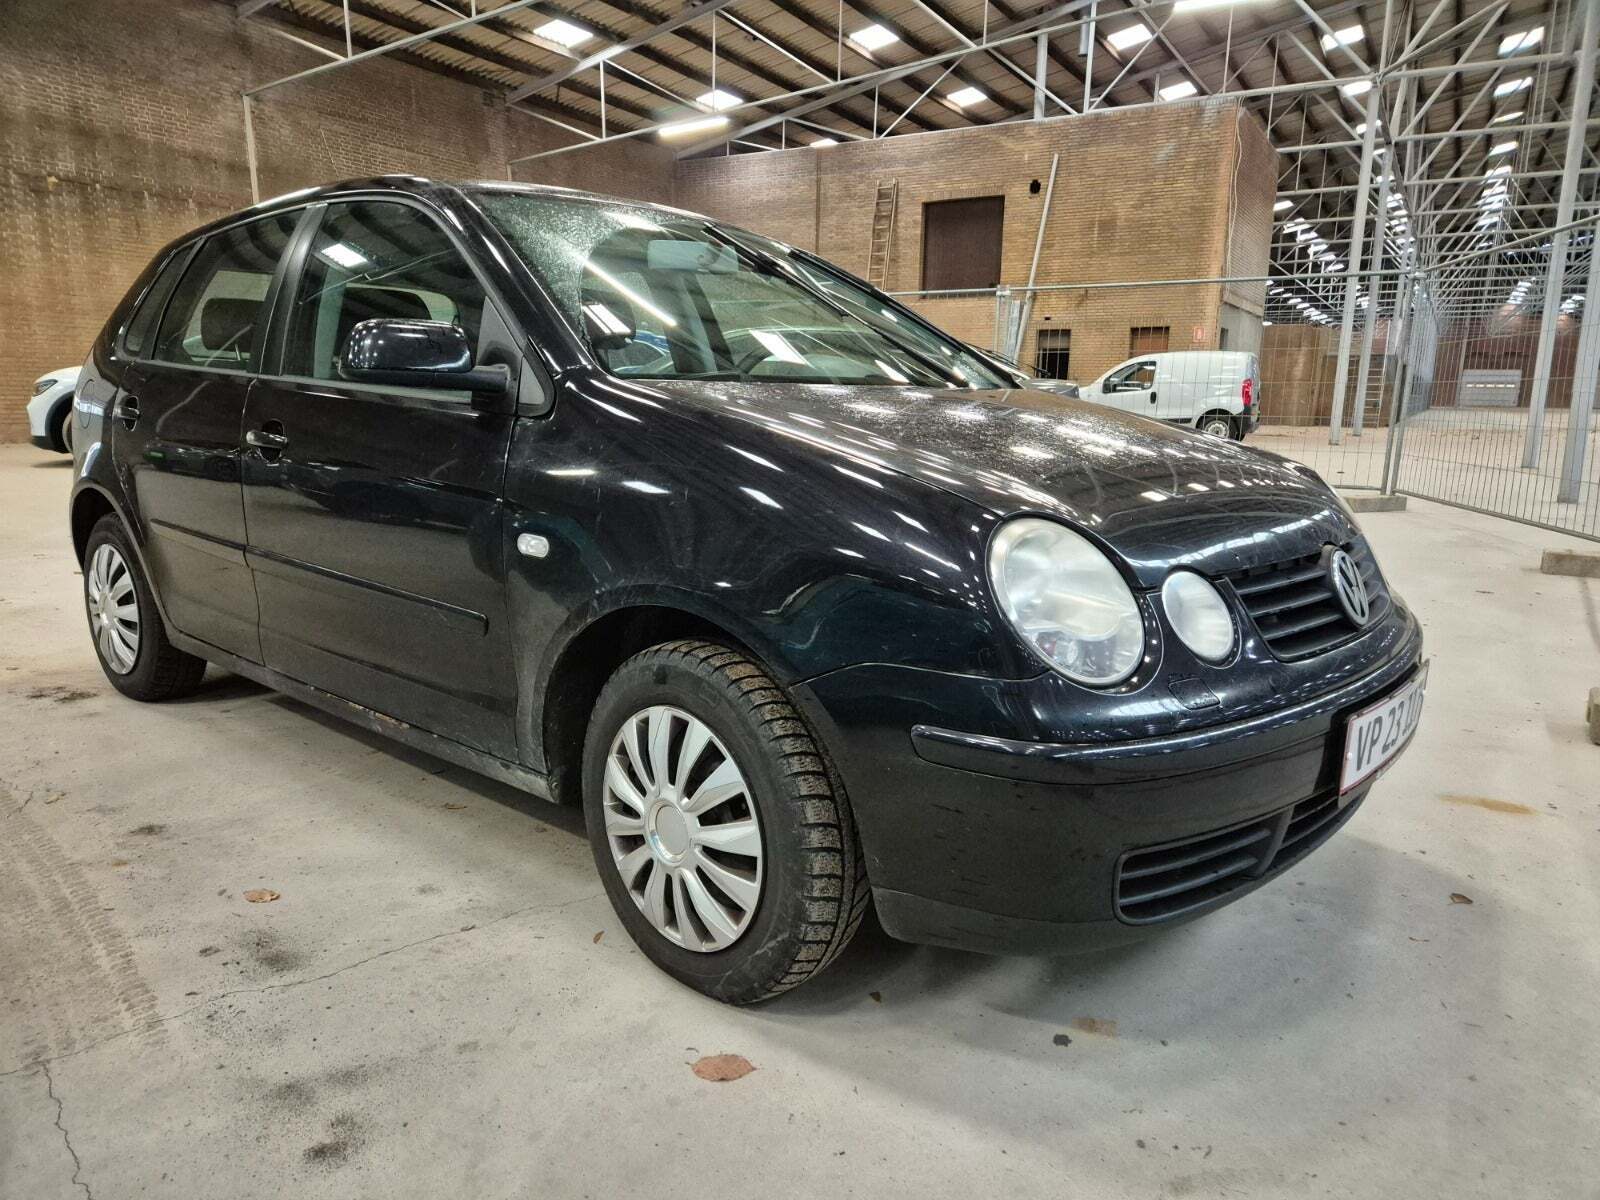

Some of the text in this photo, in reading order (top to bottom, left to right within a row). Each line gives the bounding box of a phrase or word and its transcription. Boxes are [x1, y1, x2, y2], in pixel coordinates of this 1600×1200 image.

[1332, 551, 1369, 624] VW
[1356, 715, 1383, 772] VP
[1381, 700, 1405, 755] 23
